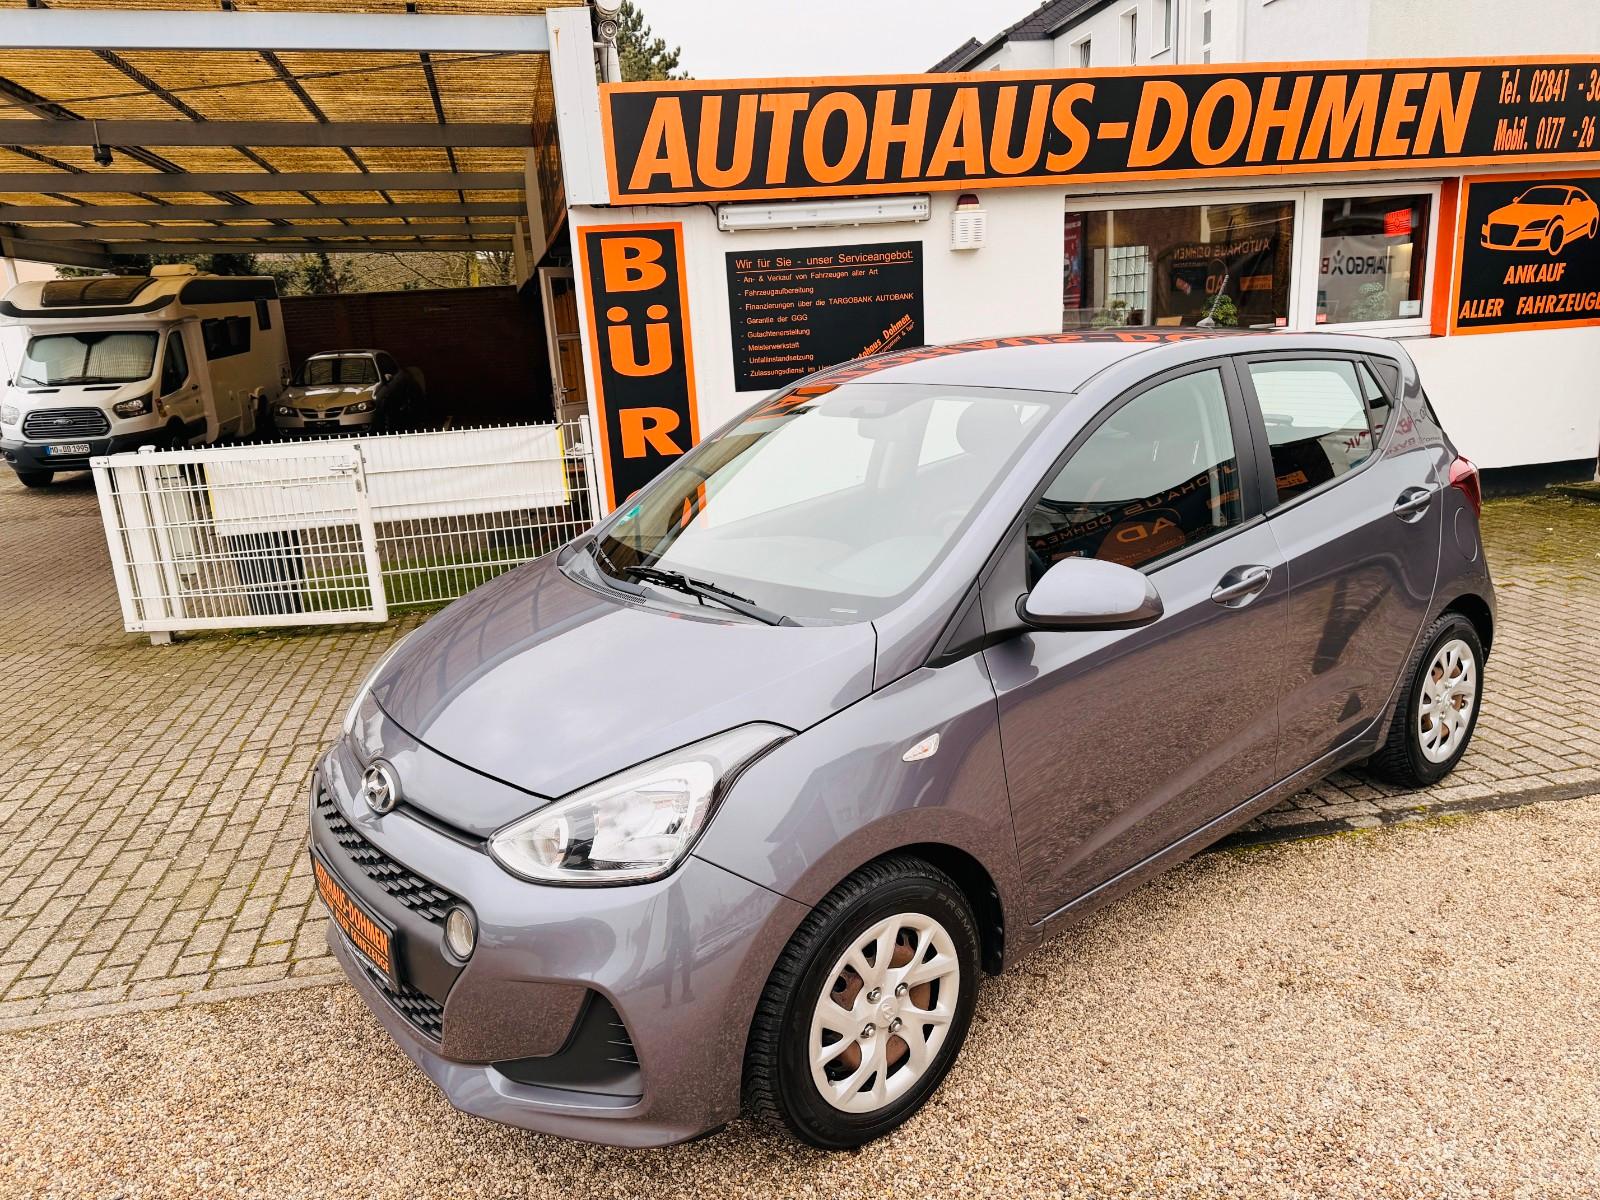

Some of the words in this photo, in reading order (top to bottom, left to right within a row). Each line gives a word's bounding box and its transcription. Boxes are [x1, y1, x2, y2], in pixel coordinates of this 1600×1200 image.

[1499, 69, 1521, 104] Tel.
[1530, 69, 1570, 102] 02841
[628, 72, 1481, 190] AUTOHAUS-DOHMEN
[1494, 116, 1528, 151] Mobil.
[1536, 116, 1566, 149] 0177
[736, 259, 752, 269] Wir
[758, 258, 771, 268] für
[776, 257, 792, 267] Sie
[806, 256, 833, 265] unser
[839, 250, 913, 263] Serviceangebot:
[811, 271, 849, 280] Fahrzeugen
[852, 269, 866, 277] aller
[869, 268, 879, 276] Art
[1504, 263, 1566, 284] ANKAUF
[744, 287, 814, 297] Fahrzeugaufbereitung
[745, 302, 795, 311] Finanzierungen
[797, 299, 813, 308] über
[816, 298, 826, 306] die
[829, 296, 873, 305] TARGOBANK
[876, 292, 914, 302] AUTOBANK
[1459, 299, 1504, 319] ALLER
[746, 317, 774, 325] Garantie
[777, 315, 788, 323] der
[882, 313, 911, 340] Dohmen
[747, 328, 811, 338] Gutachtenerstellung
[748, 341, 800, 352] Meisterwerkstatt
[749, 354, 814, 364] Unfallinstandsetzung
[601, 237, 684, 501] BÜR
[750, 366, 804, 377] Zulassungsdienst
